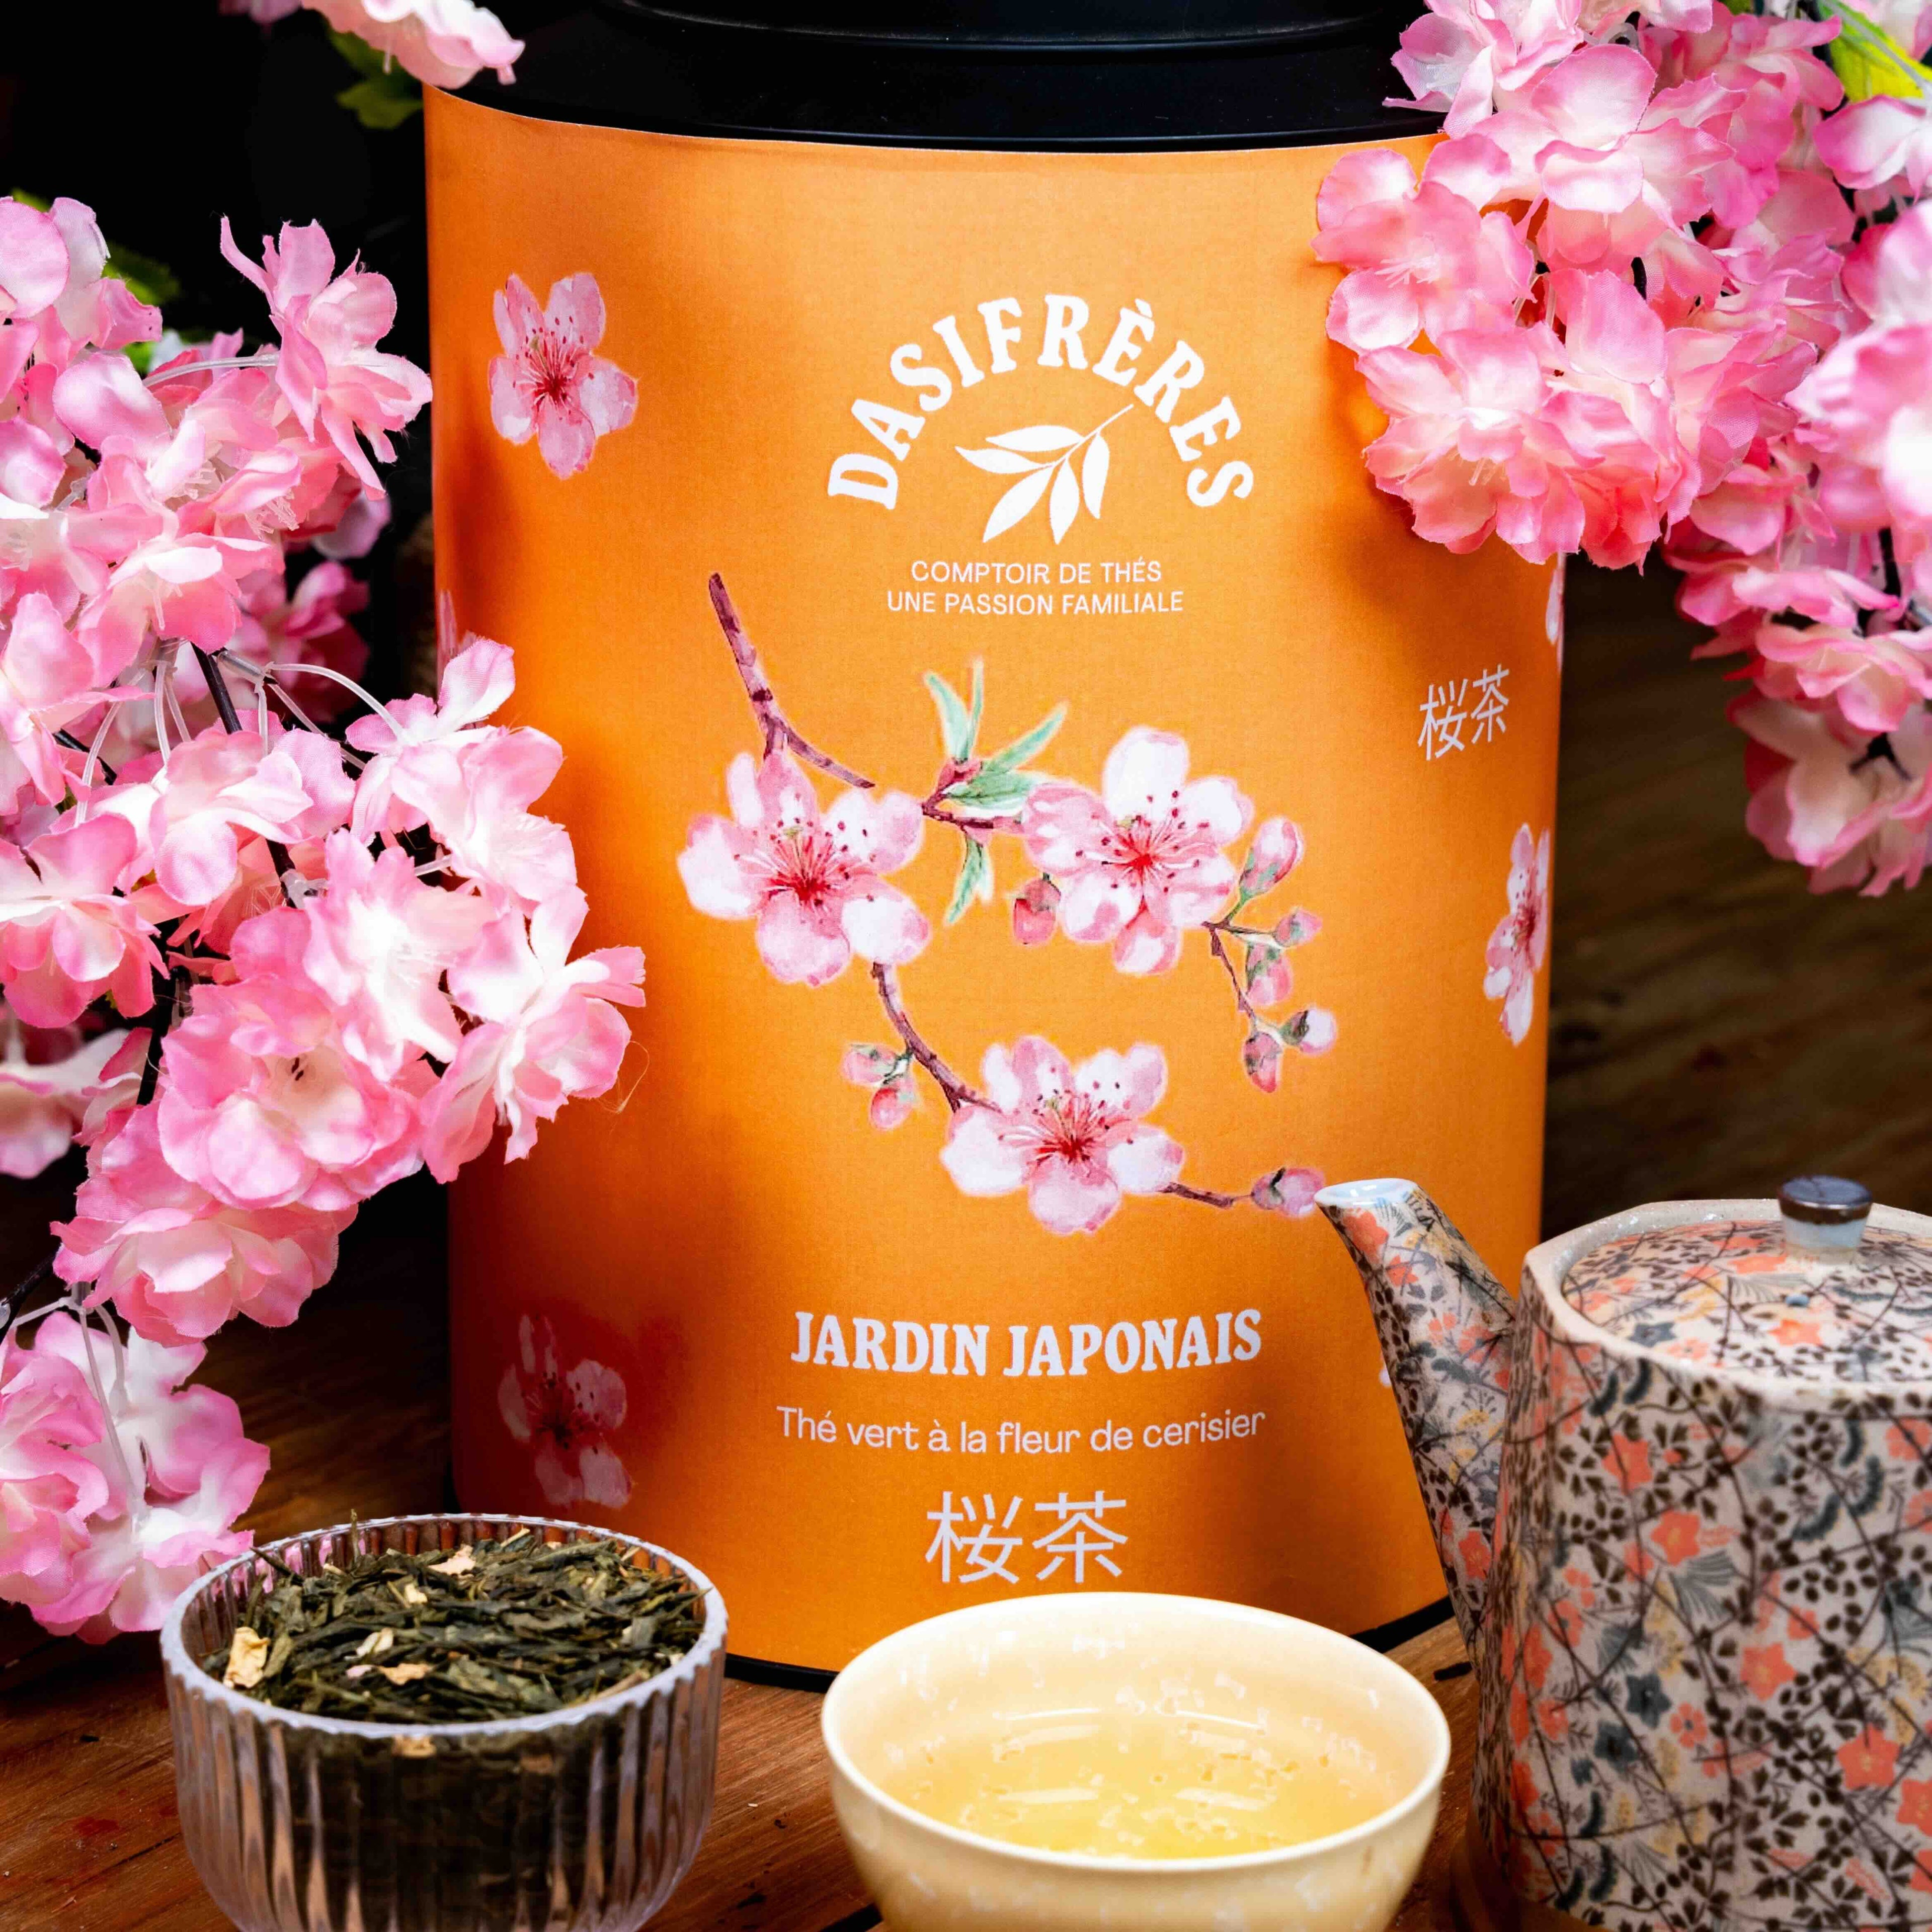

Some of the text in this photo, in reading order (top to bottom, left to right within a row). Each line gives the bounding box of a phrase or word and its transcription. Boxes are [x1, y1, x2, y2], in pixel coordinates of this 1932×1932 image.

[911, 555, 1162, 585] COMPTOIR DE THÉS
[888, 590, 1183, 615] UNE PASSION FAMILIALE
[1418, 663, 1509, 761] 桜茶
[791, 1309, 1260, 1377] JARDIN JAPONAIS
[777, 1406, 1265, 1454] Thé vert à la fleur de cerisier
[925, 1491, 1128, 1583] 桜茶
